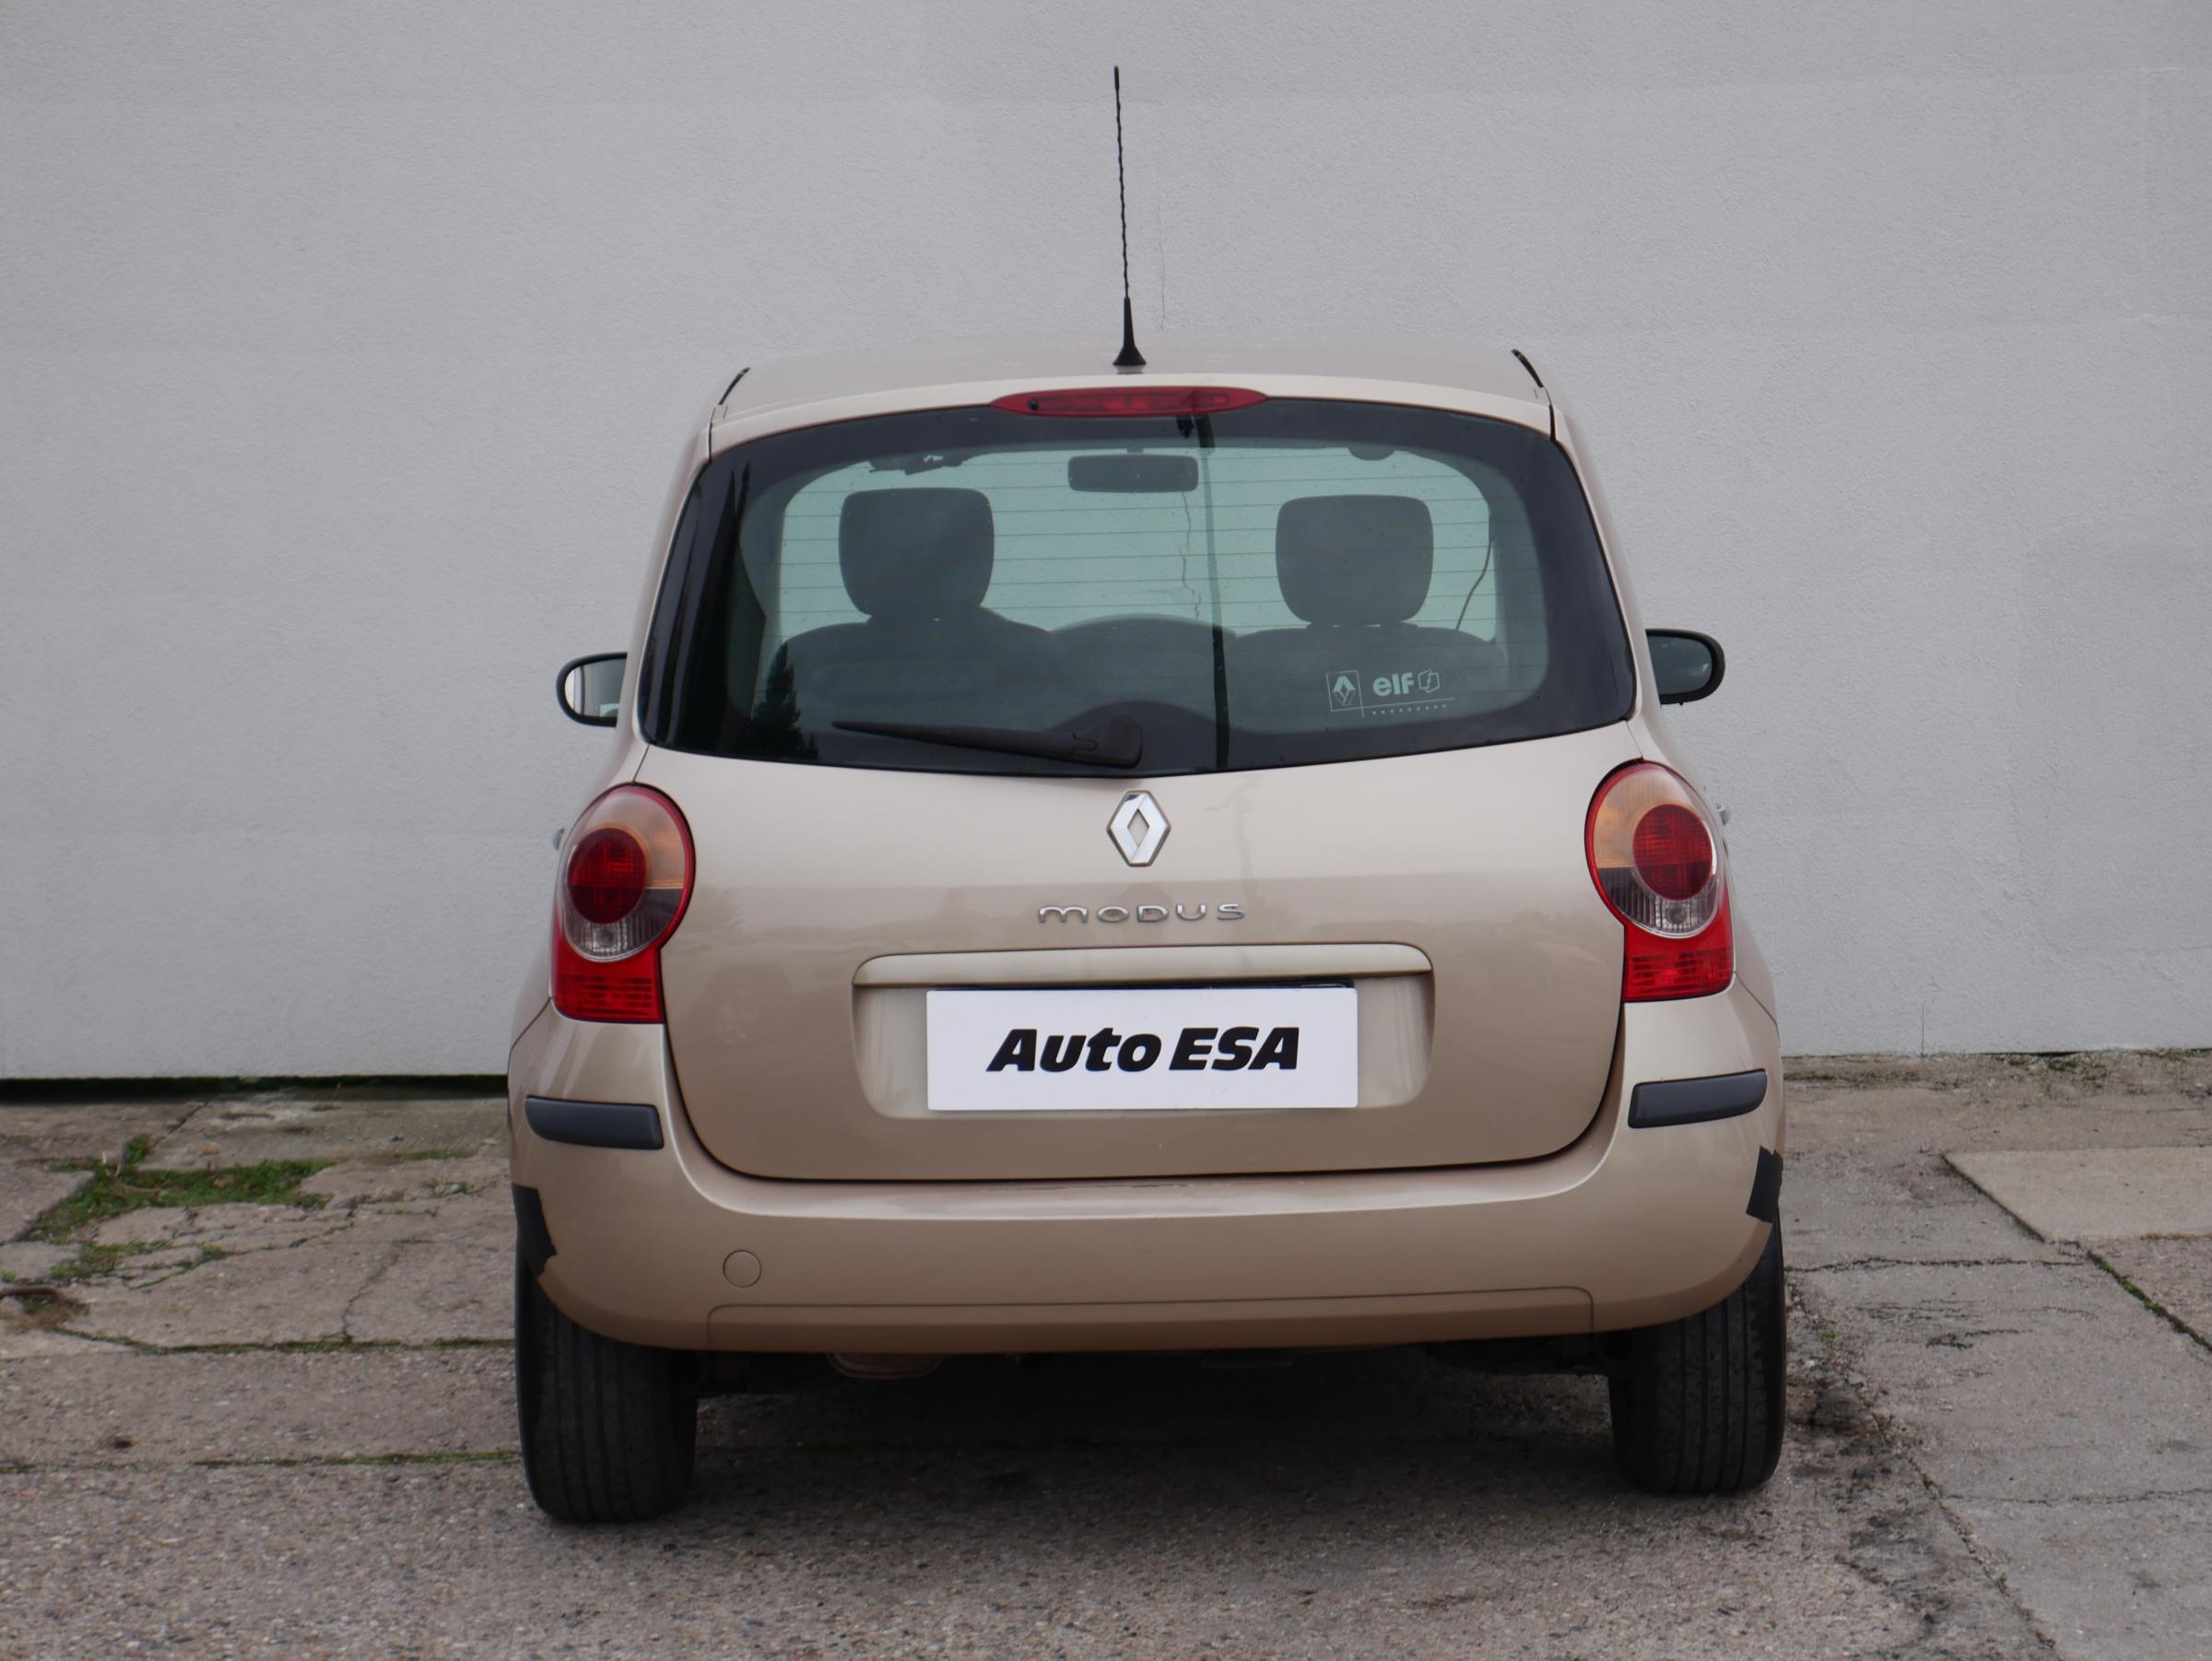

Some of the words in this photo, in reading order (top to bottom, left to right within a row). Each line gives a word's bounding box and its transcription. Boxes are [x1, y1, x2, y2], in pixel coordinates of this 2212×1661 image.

[1372, 672, 1414, 697] elf
[1038, 903, 1245, 923] MODUS
[985, 1027, 1162, 1072] Auto
[1169, 1026, 1300, 1071] ESA
